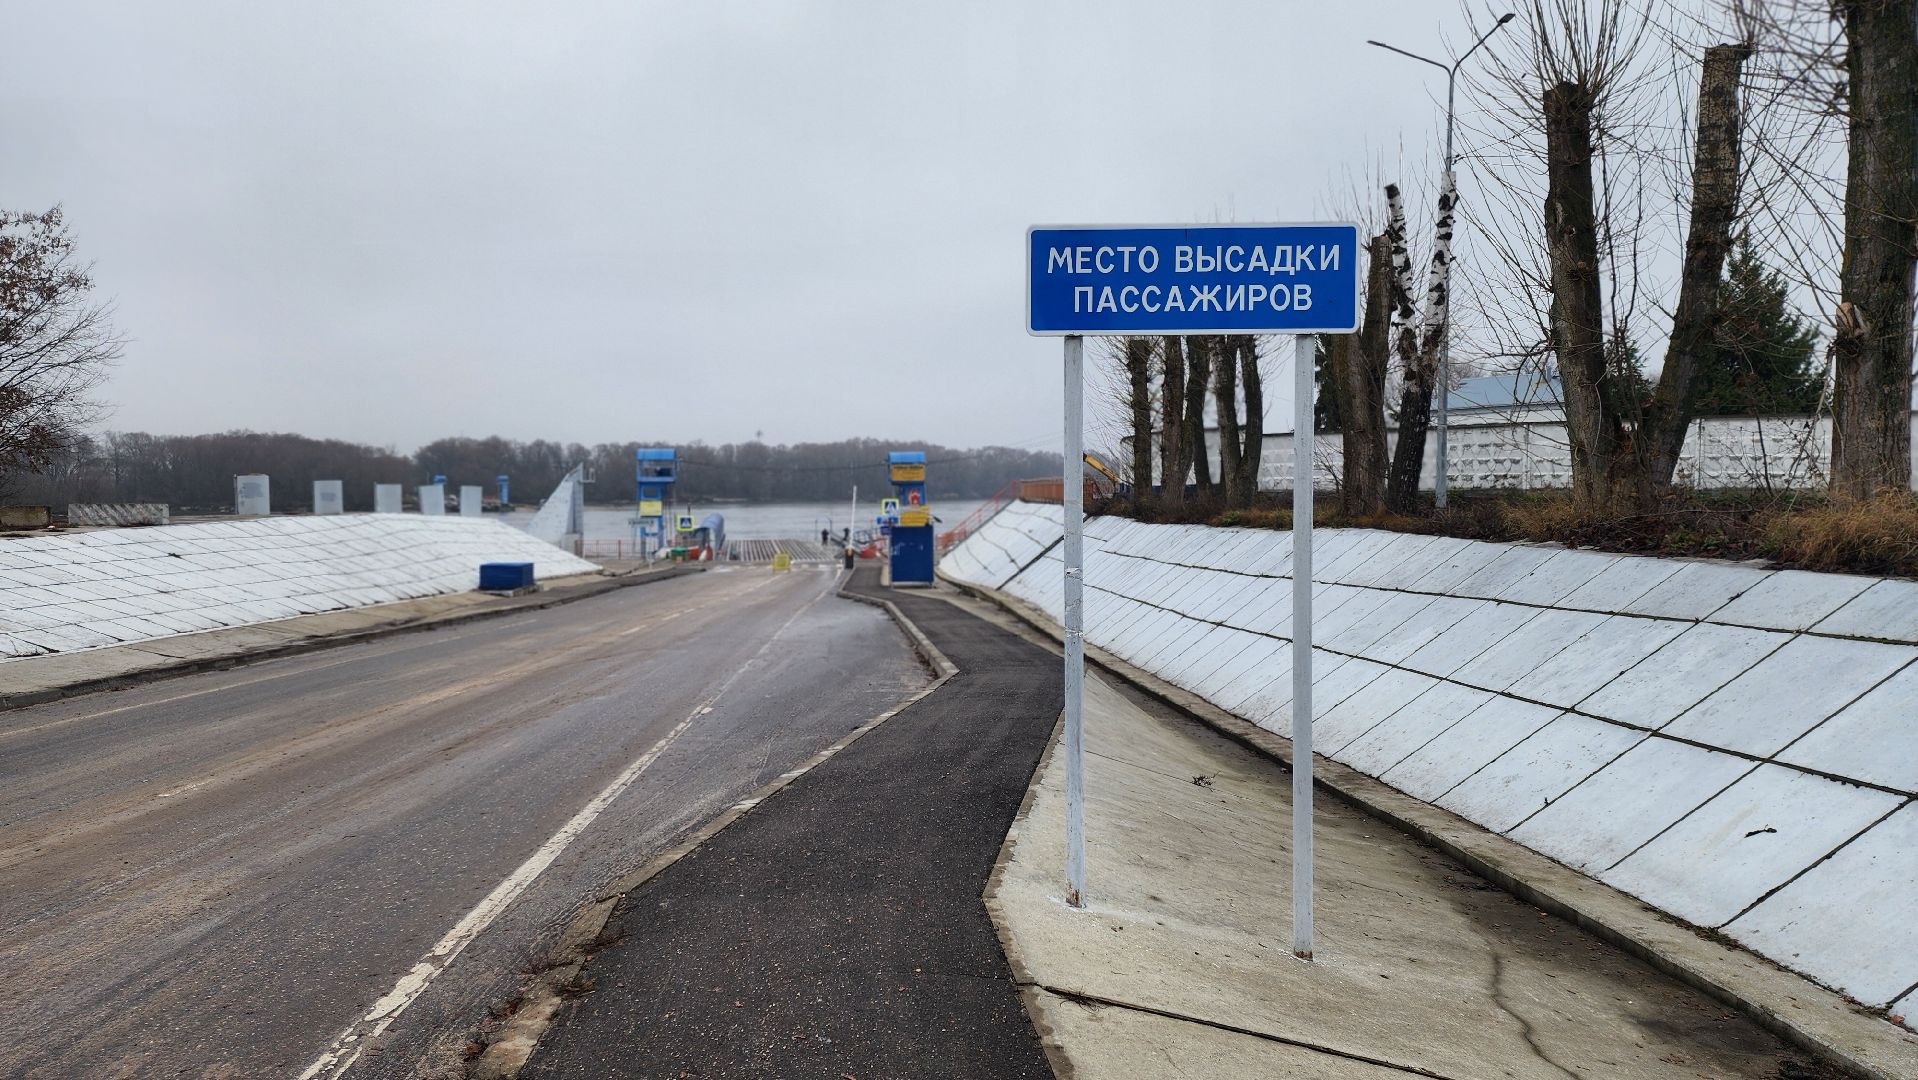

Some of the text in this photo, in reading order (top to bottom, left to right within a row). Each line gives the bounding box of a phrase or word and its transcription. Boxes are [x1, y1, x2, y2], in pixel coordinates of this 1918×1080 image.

[1047, 244, 1340, 275] МЕСТО ВЫСАДКИ
[1073, 284, 1313, 313] ПАССАЖИРОВ
